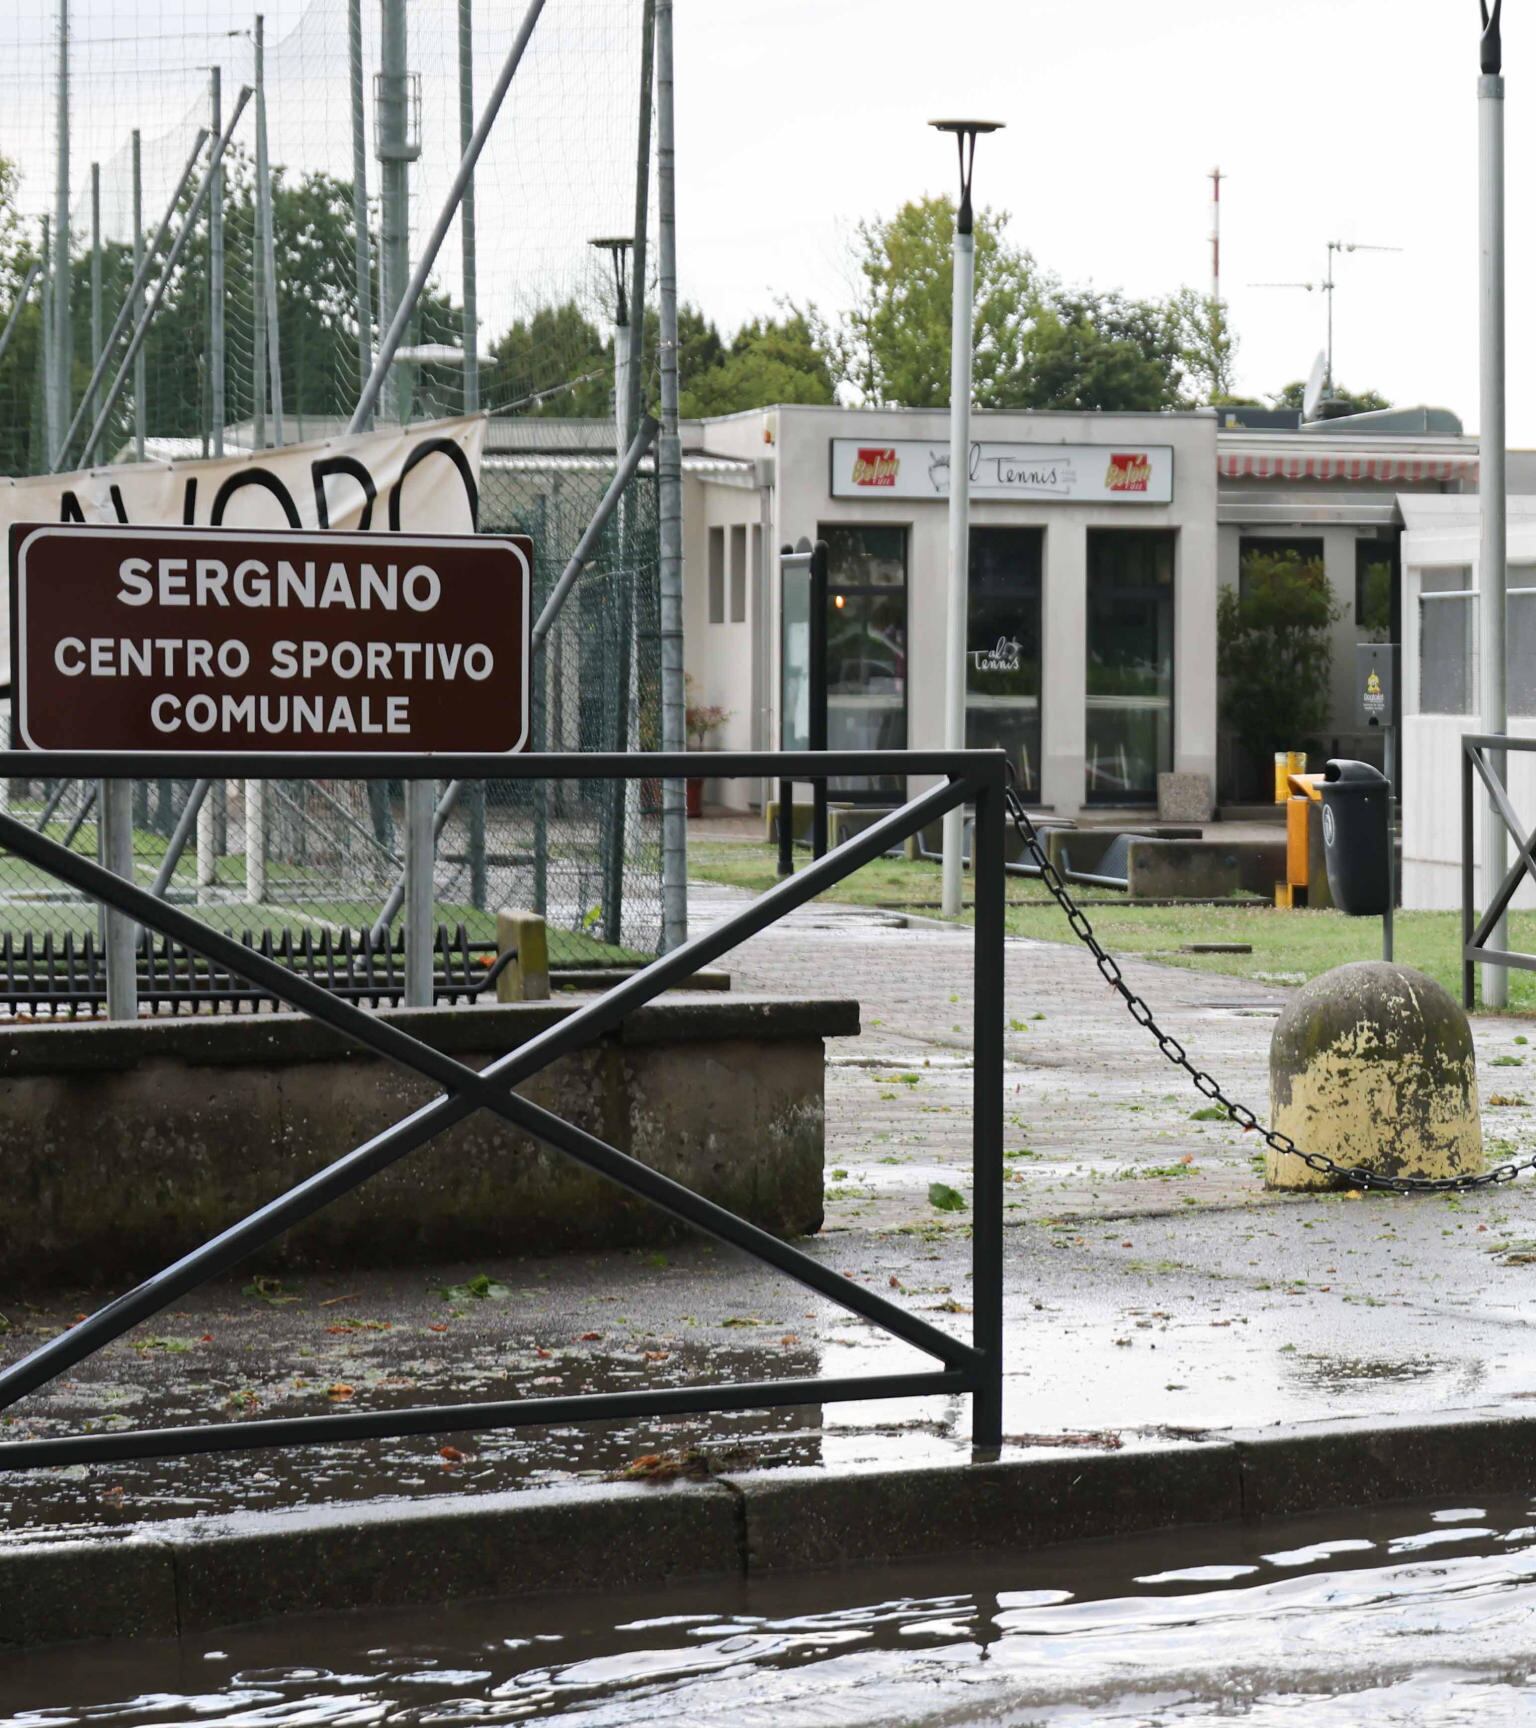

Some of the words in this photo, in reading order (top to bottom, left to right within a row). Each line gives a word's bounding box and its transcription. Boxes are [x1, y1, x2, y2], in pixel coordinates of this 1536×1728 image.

[986, 456, 1057, 484] Tennis
[116, 557, 442, 613] SERGNANO
[54, 636, 251, 679] CENTRO
[269, 640, 495, 682] SPORTIVO
[967, 649, 1020, 670] Tennis
[149, 692, 411, 734] COMUNALE
